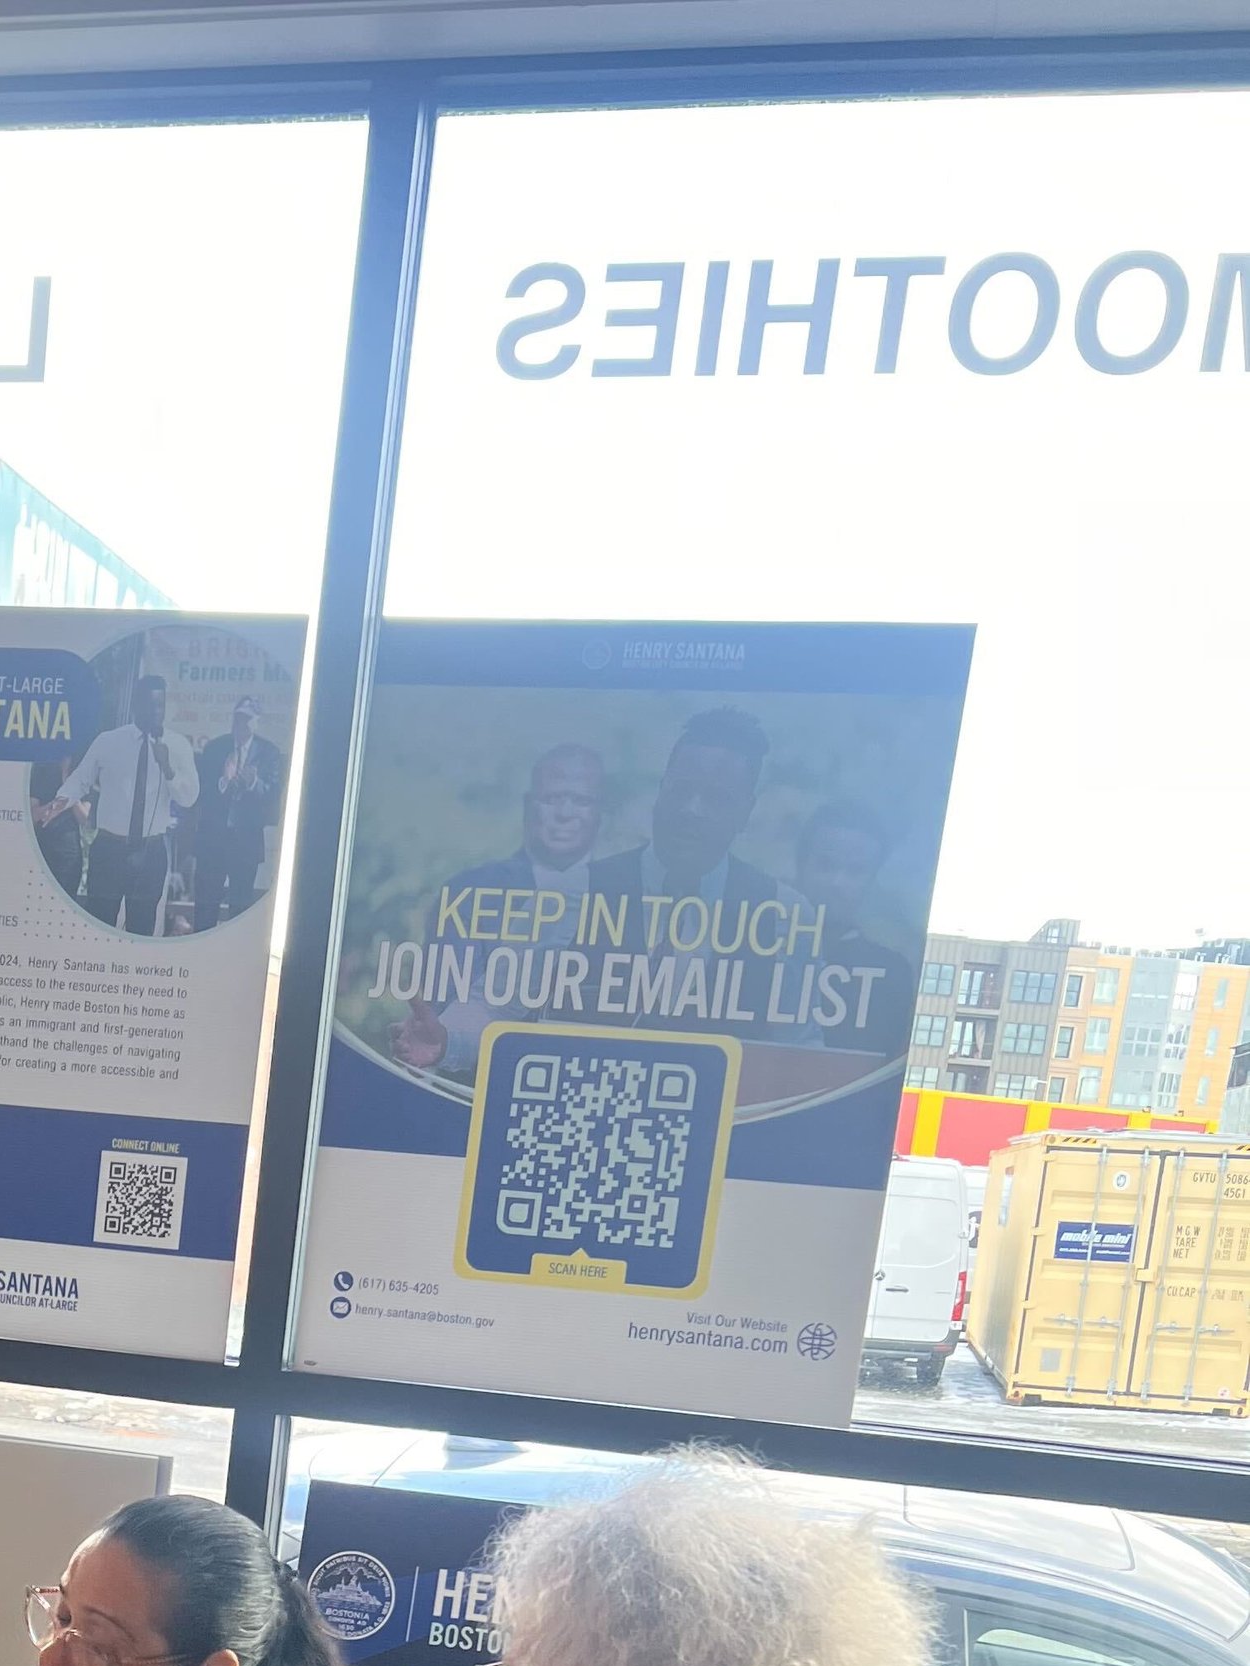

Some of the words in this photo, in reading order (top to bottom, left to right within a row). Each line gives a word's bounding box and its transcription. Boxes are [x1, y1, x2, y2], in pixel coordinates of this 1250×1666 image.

[623, 641, 672, 658] HENRY
[674, 642, 745, 661] SANTANA
[178, 660, 255, 681] Farmers
[435, 885, 566, 942] KEEP
[576, 893, 629, 947] IN
[642, 896, 826, 957] TOUCH
[28, 956, 58, 970] Henry
[64, 959, 105, 972] Santana
[111, 962, 129, 974] has
[135, 963, 173, 977] worked
[179, 967, 189, 978] to
[36, 978, 46, 989] to
[50, 979, 65, 990] the
[69, 982, 119, 994] resources
[123, 984, 144, 998] they
[148, 987, 173, 998] need
[178, 988, 187, 999] to
[367, 940, 475, 1003] JOIN
[483, 946, 591, 1012] OUR
[596, 952, 755, 1022] EMAIL
[766, 961, 886, 1029] LIST
[20, 996, 49, 1010] Henry
[53, 999, 80, 1012] made
[84, 1001, 120, 1014] Boston
[123, 1004, 138, 1016] his
[141, 1005, 170, 1017] home
[173, 1009, 185, 1019] as
[9, 1018, 21, 1027] an
[26, 1019, 76, 1031] immigrant
[80, 1022, 99, 1033] and
[104, 1023, 183, 1039] first-generation
[33, 1038, 49, 1049] the
[53, 1040, 108, 1055] challenges
[113, 1045, 123, 1055] of
[128, 1047, 181, 1062] navigating
[15, 1057, 56, 1072] creating
[71, 1063, 97, 1073] more
[101, 1065, 155, 1078] accessible
[159, 1069, 179, 1080] and
[112, 1138, 149, 1150] CONNECT
[150, 1142, 180, 1153] ONLINE
[1192, 1172, 1216, 1183] GVTU
[1102, 1233, 1131, 1244] mini
[1175, 1238, 1196, 1248] TARE
[1173, 1249, 1190, 1258] NET
[548, 1262, 576, 1276] SCAN
[580, 1266, 607, 1279] HERE
[358, 1277, 386, 1292] (617)
[389, 1280, 439, 1295] 635-4205
[38, 1299, 78, 1312] AT-LARGE
[355, 1304, 495, 1328] henry.santana@boston.gov
[687, 1312, 710, 1325] Visit
[715, 1314, 737, 1327] Our
[740, 1317, 788, 1332] Website
[628, 1322, 788, 1353] henrysantana.com
[325, 1608, 370, 1619] BOSTONIA
